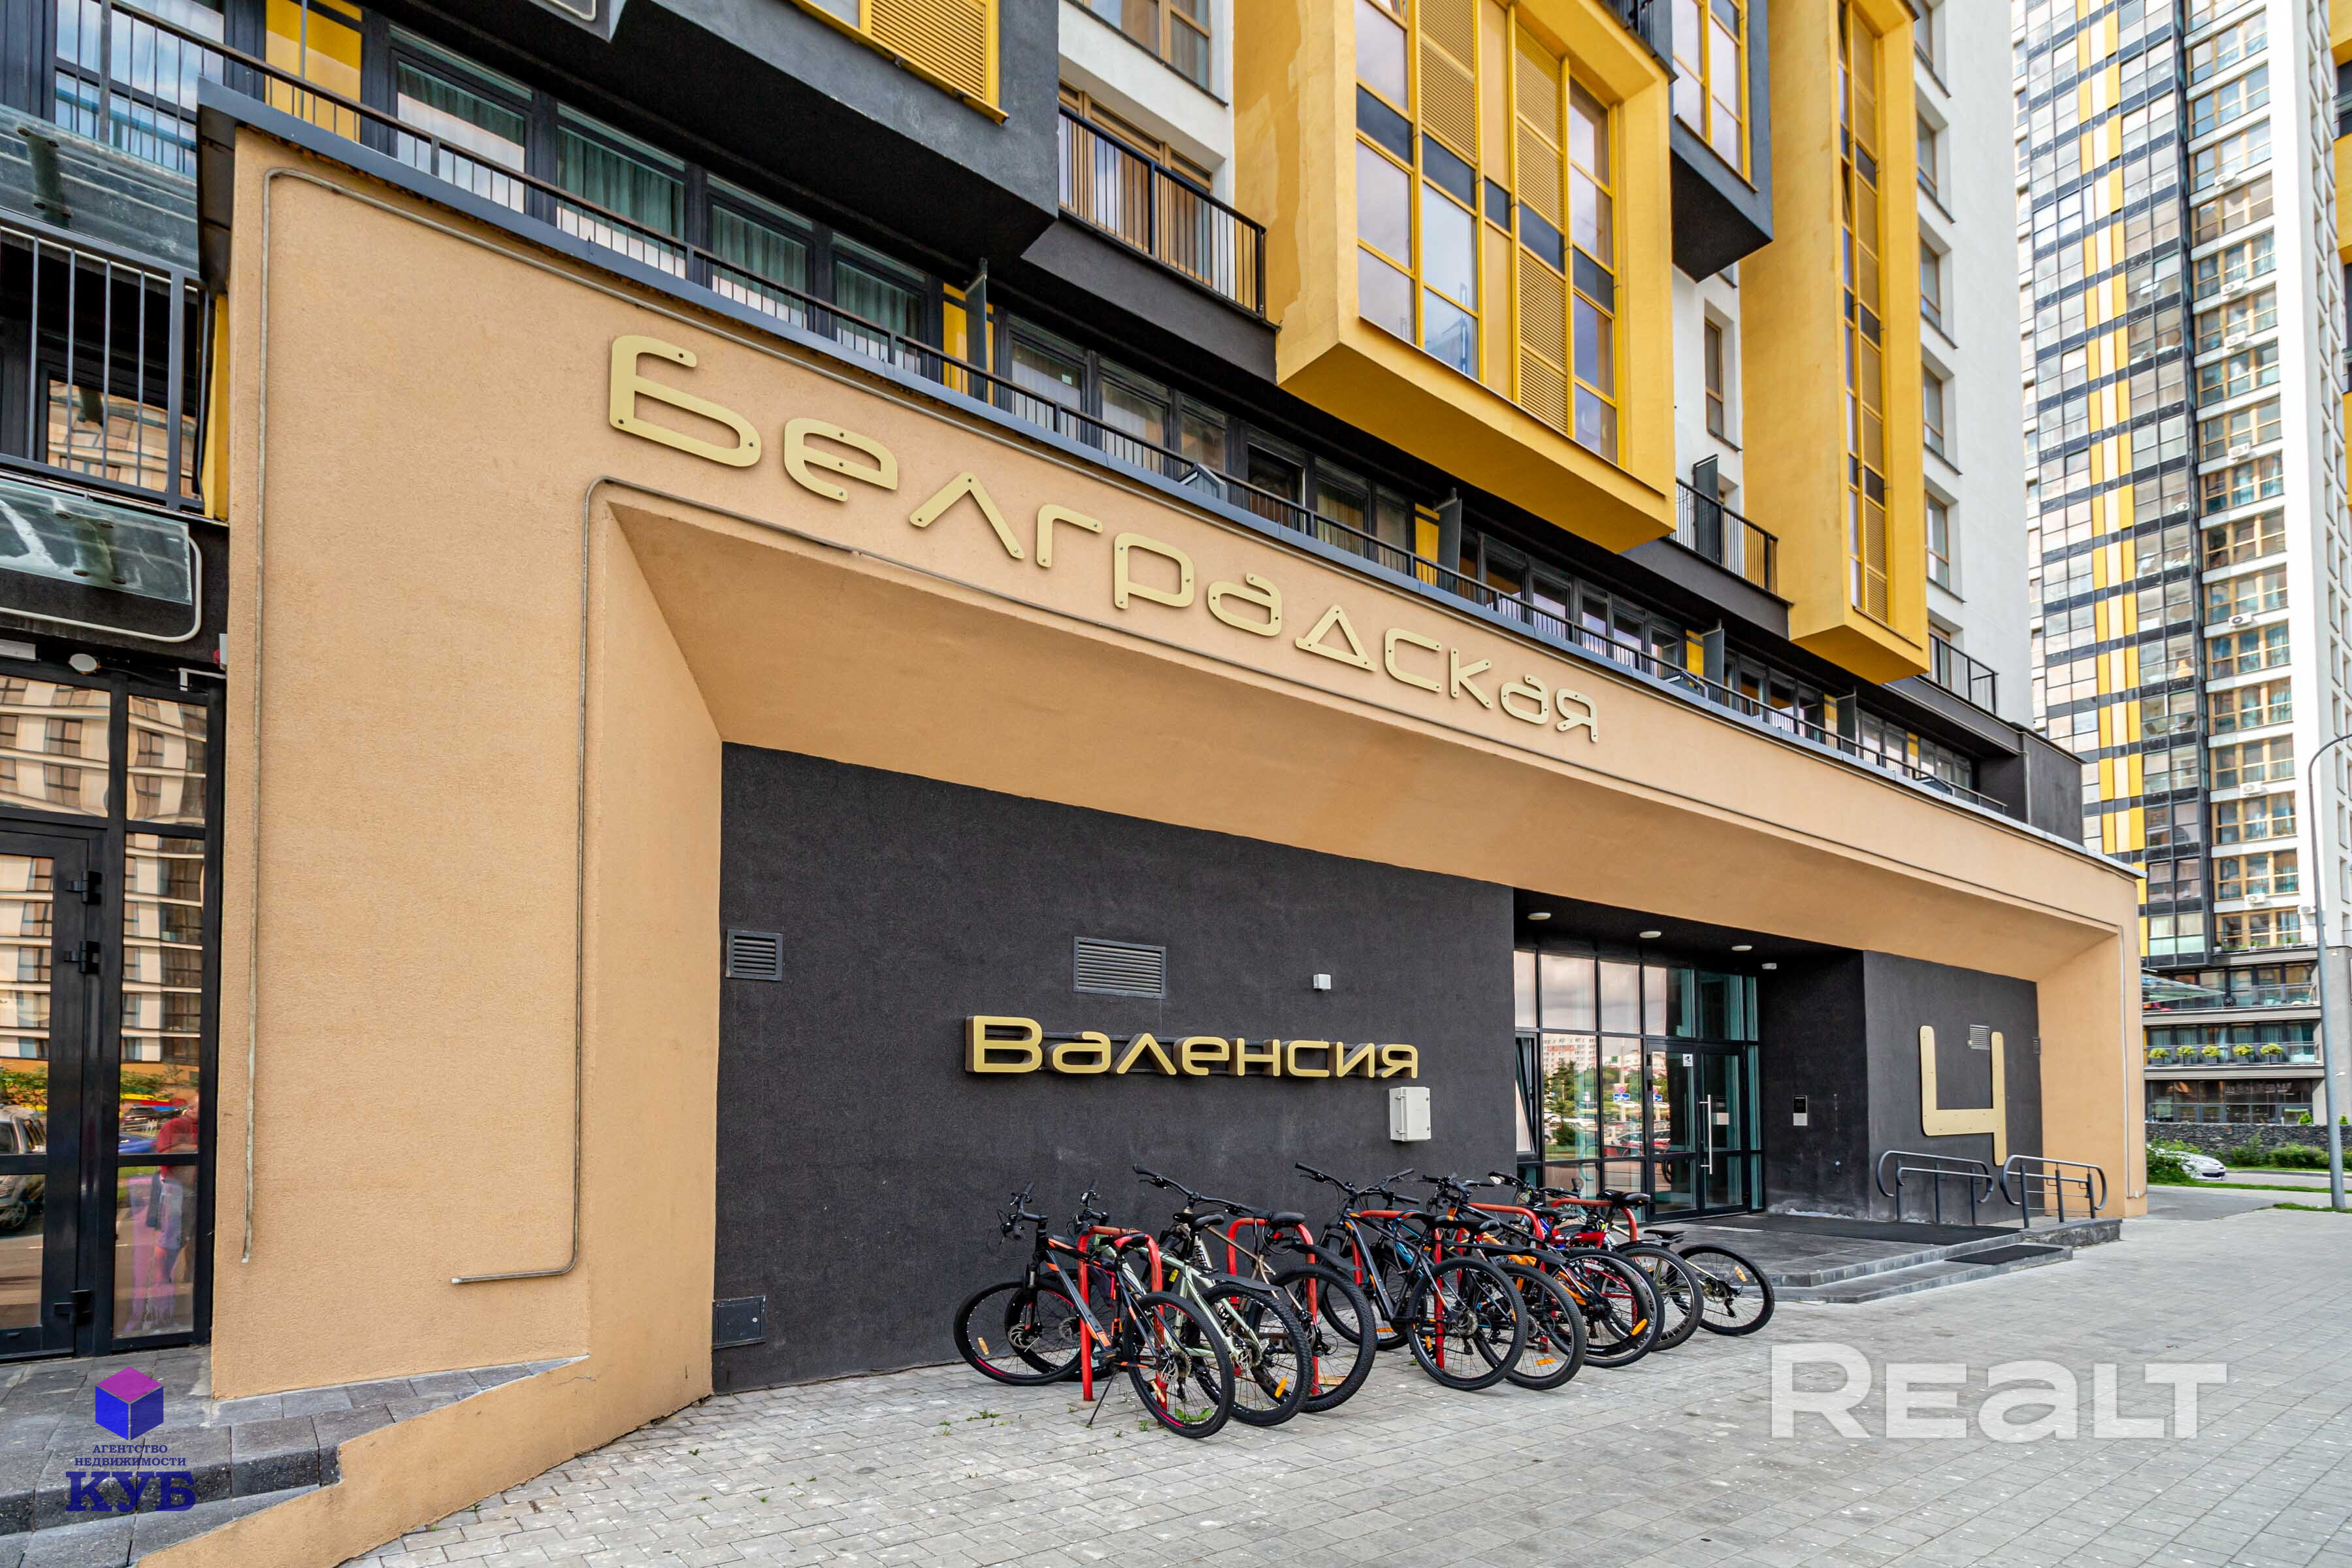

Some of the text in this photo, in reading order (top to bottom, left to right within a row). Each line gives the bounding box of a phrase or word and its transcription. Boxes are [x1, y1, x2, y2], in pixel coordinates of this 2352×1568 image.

[609, 335, 1598, 743] Белградская
[965, 1015, 1418, 1079] Валенсия
[1919, 1025, 2007, 1166] 4
